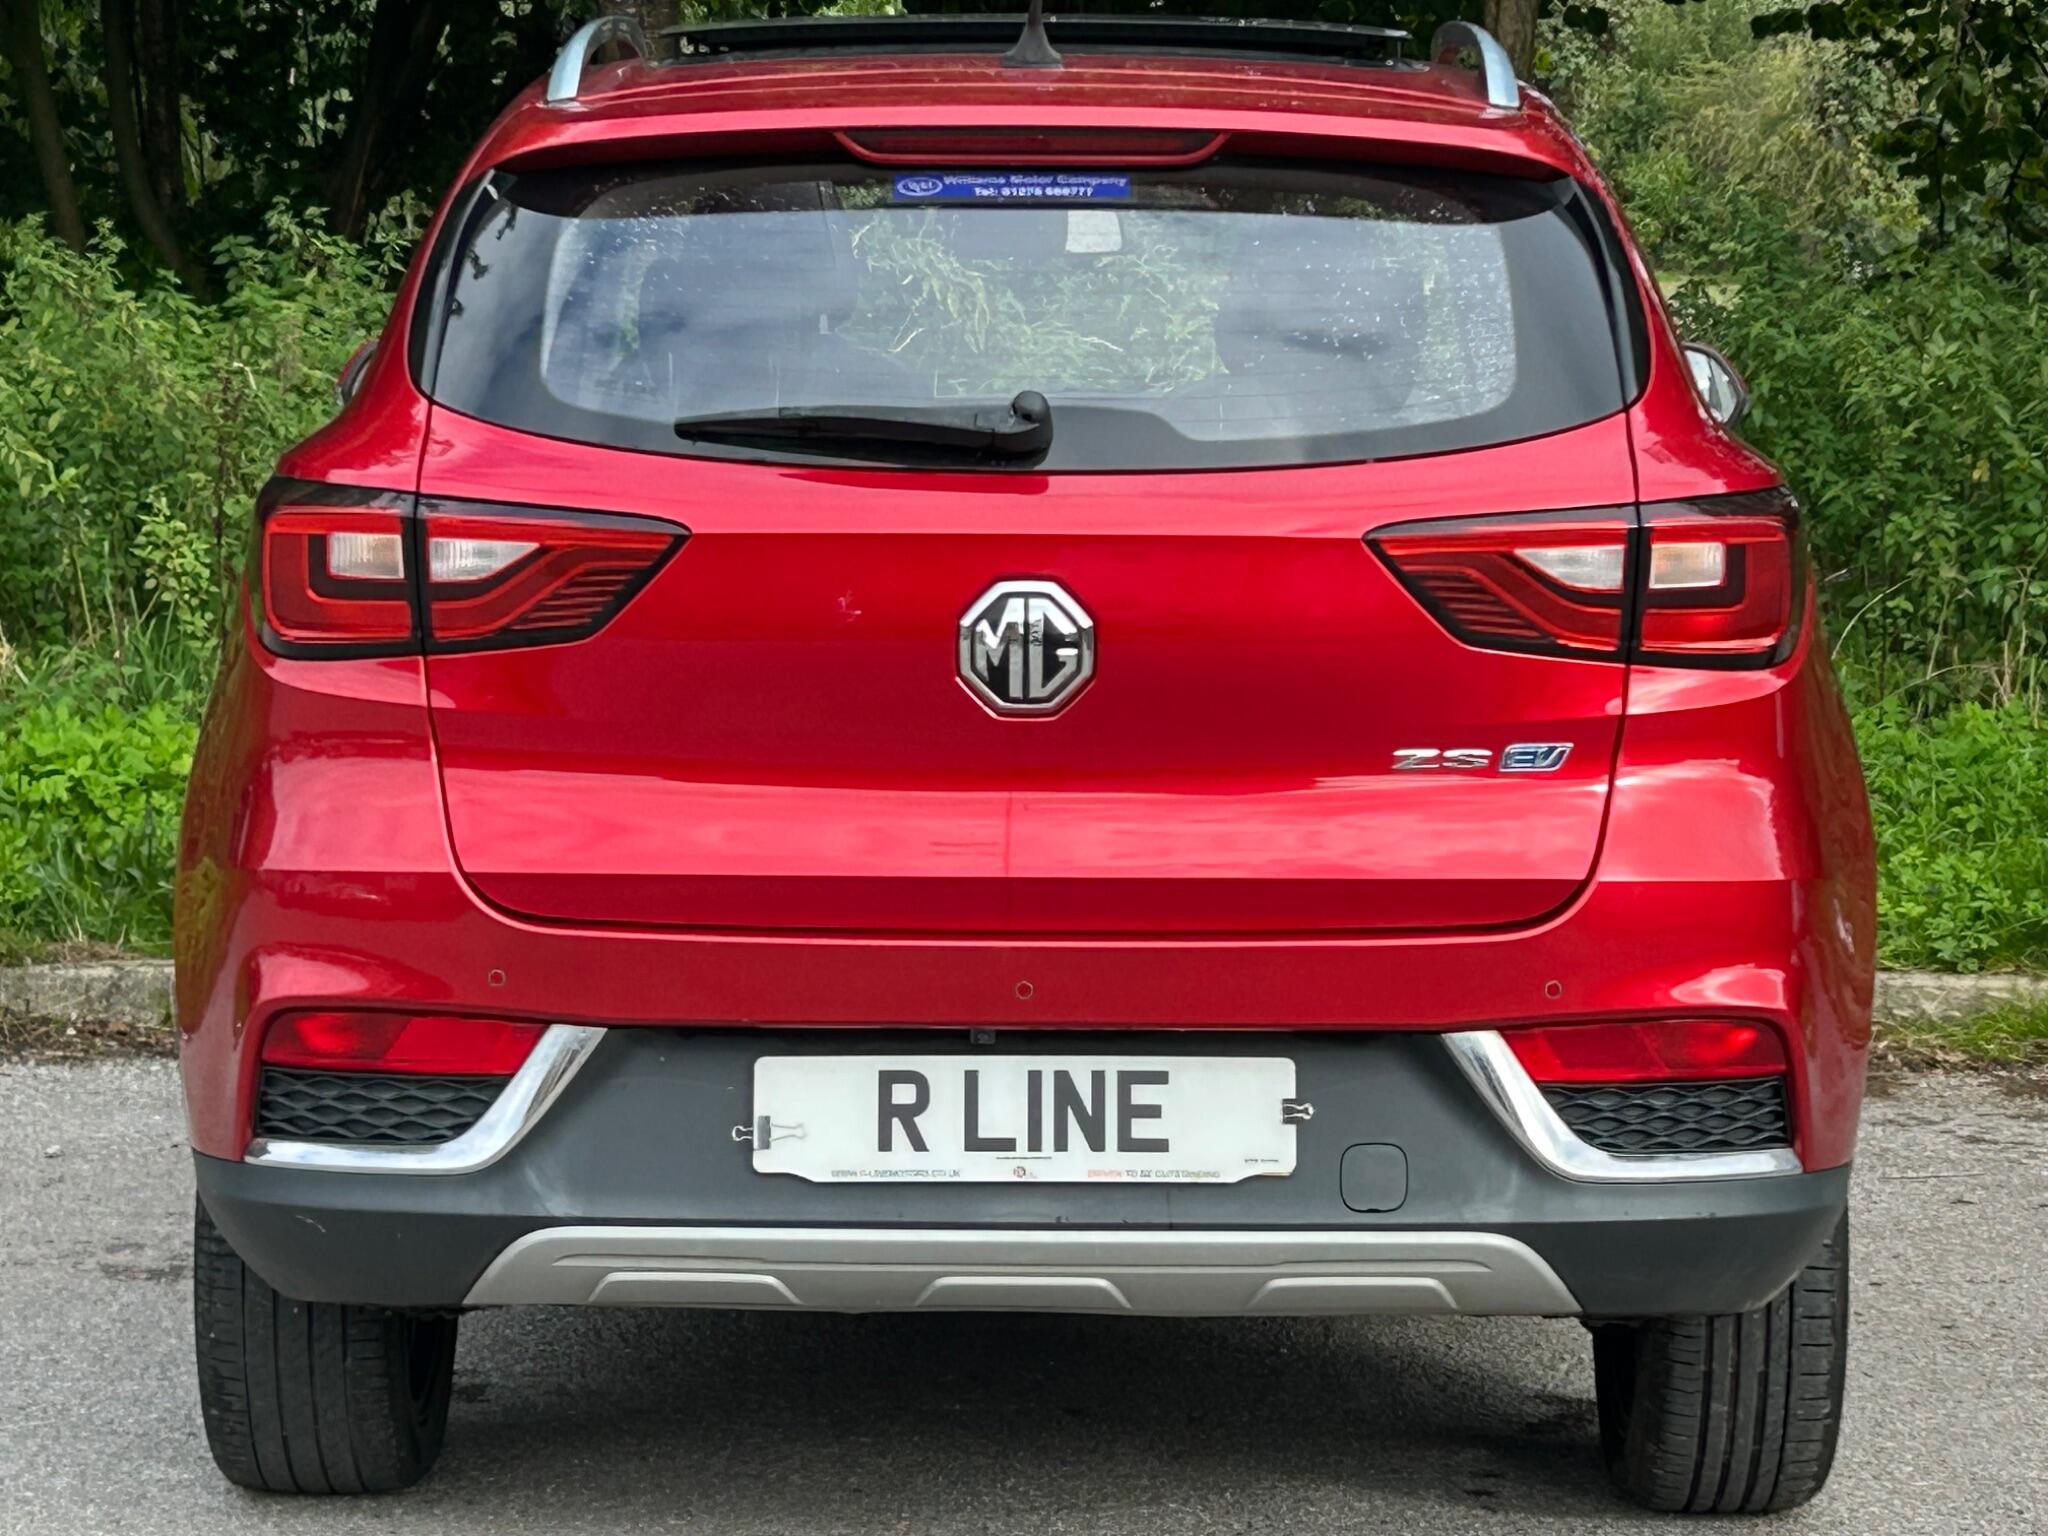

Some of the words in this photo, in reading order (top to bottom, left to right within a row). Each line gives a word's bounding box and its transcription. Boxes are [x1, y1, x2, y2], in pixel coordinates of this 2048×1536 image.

[1056, 175, 1127, 187] Company
[971, 594, 1082, 702] MG
[1391, 748, 1493, 769] ZS
[1506, 746, 1571, 769] EV
[877, 1069, 931, 1153] R
[963, 1069, 1170, 1153] LINE
